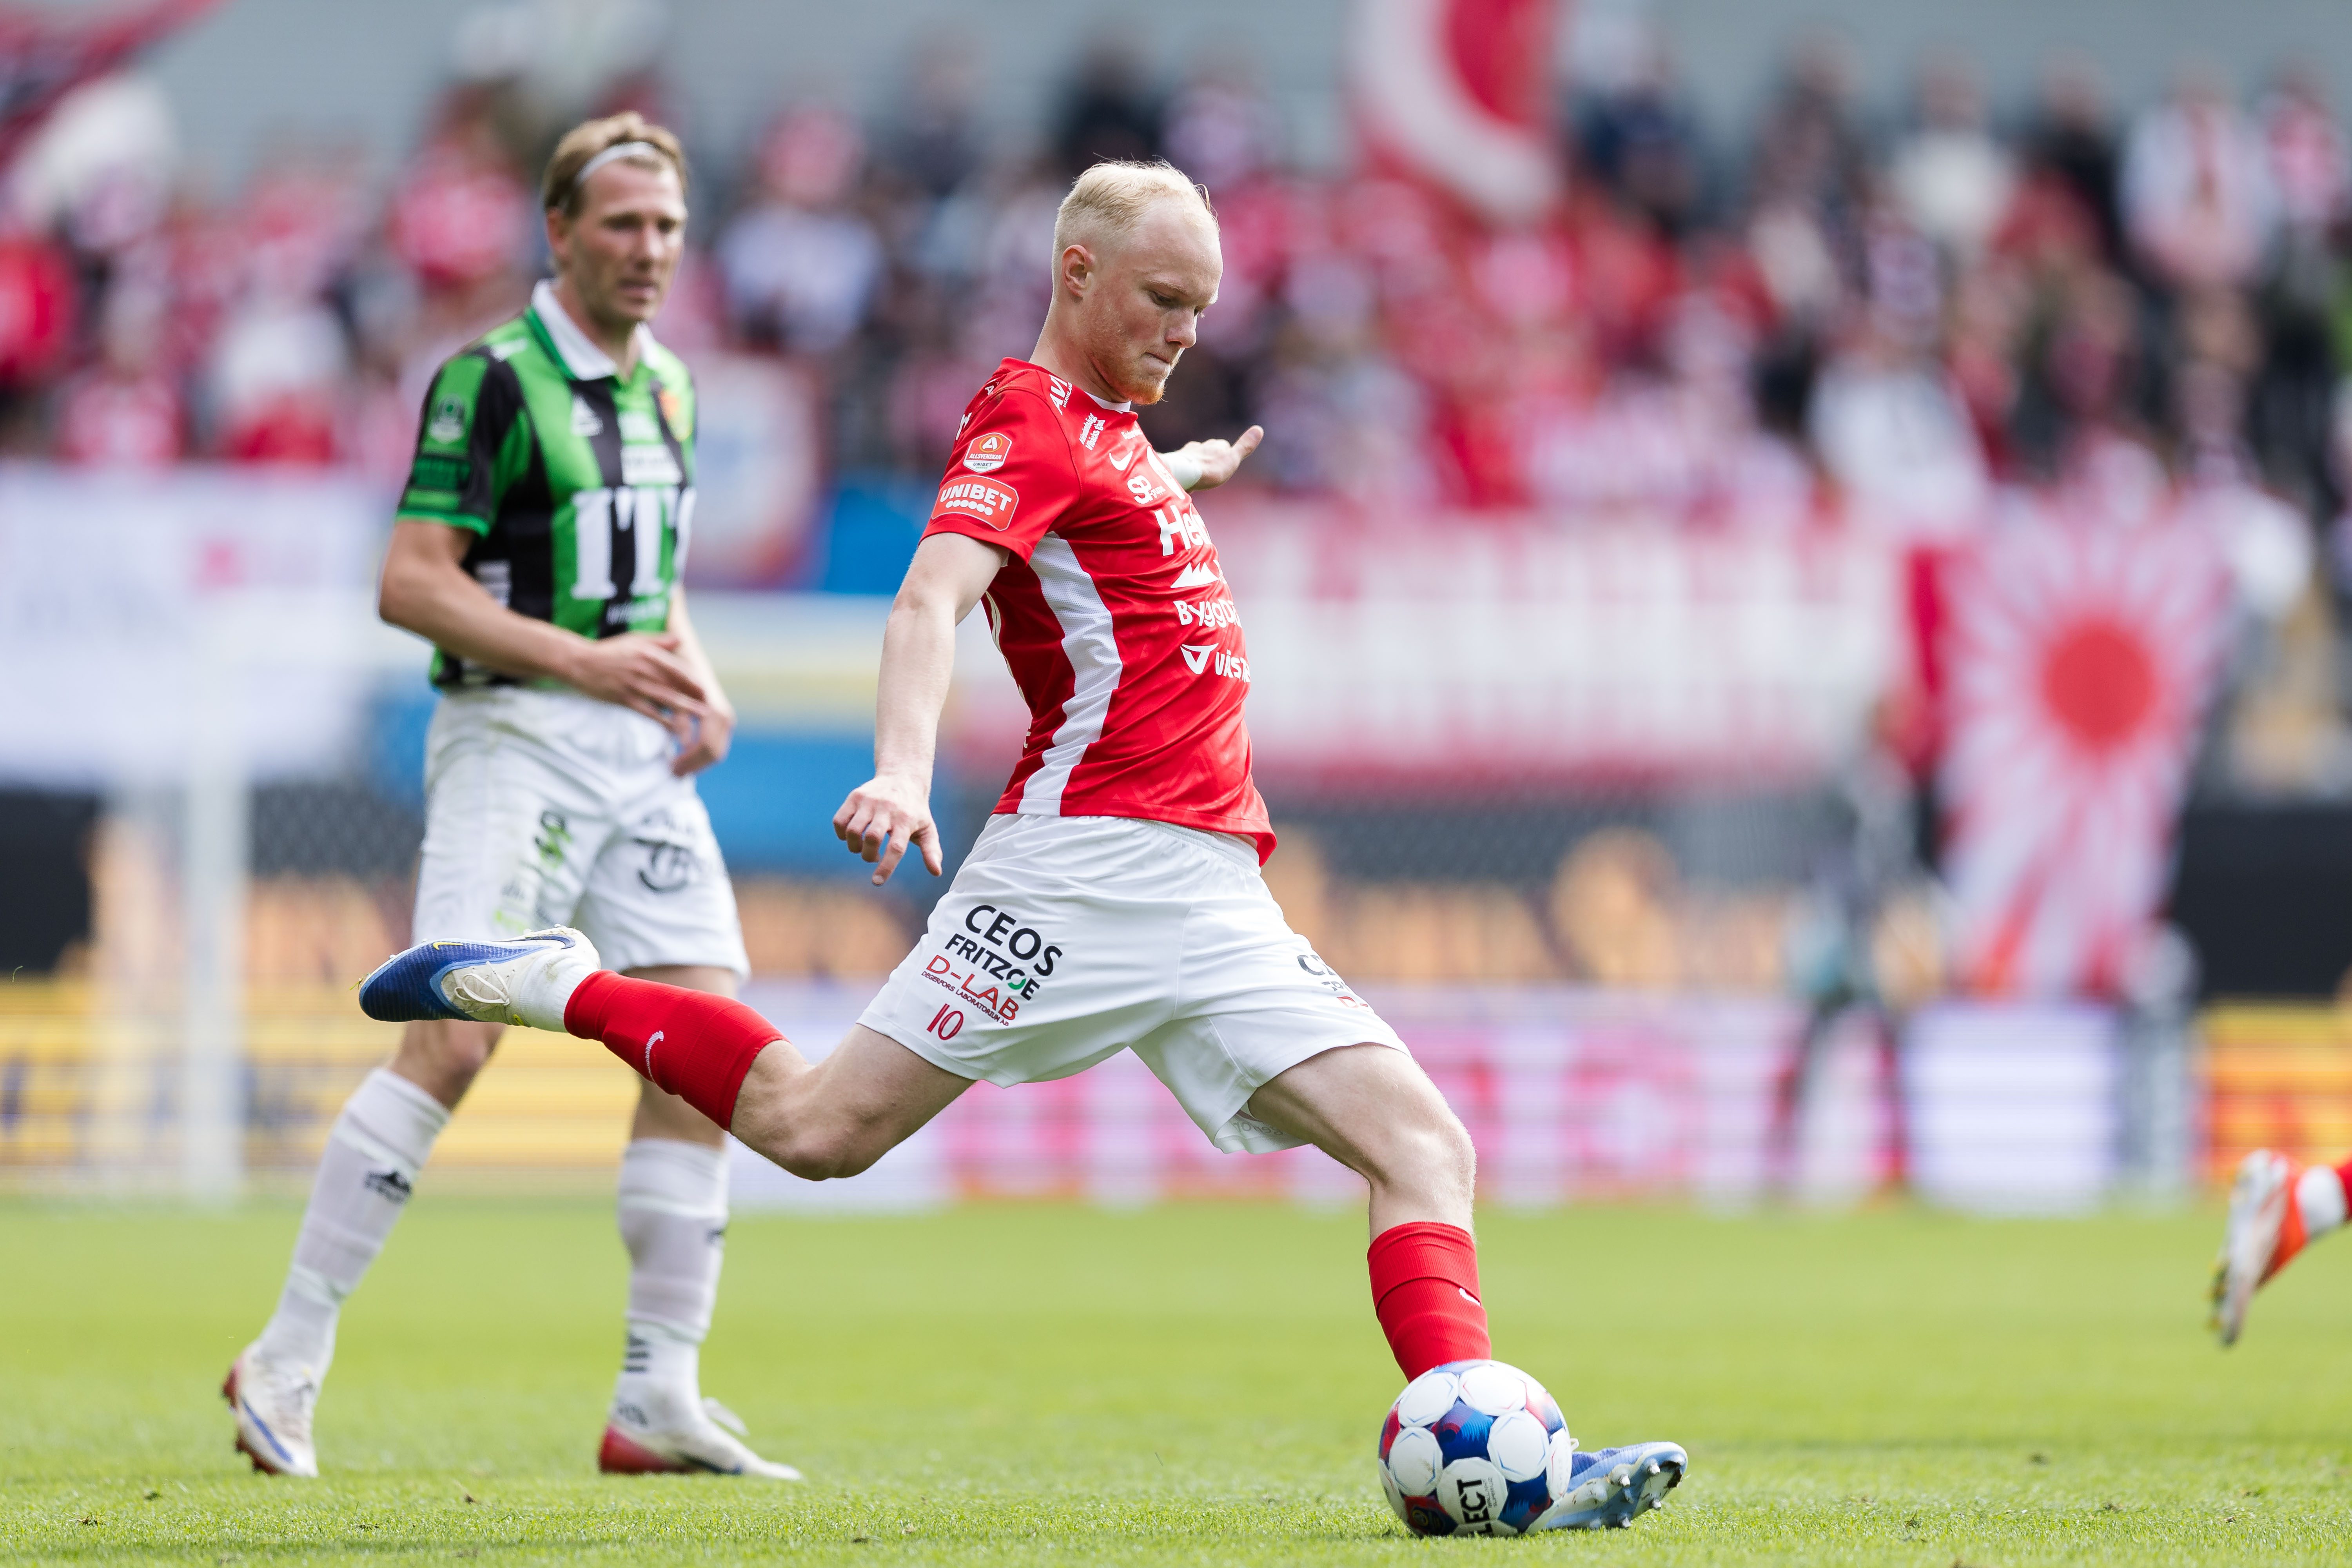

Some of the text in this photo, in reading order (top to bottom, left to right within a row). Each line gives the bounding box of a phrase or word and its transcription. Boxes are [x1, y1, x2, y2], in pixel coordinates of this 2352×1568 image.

[940, 483, 1012, 511] UNIBET
[965, 905, 1063, 976] CEOS
[921, 971, 955, 992] DEGERFORS
[956, 989, 1001, 1022] LABORATORIUM
[926, 955, 1019, 1020] D-LAB
[926, 1003, 964, 1040] 10
